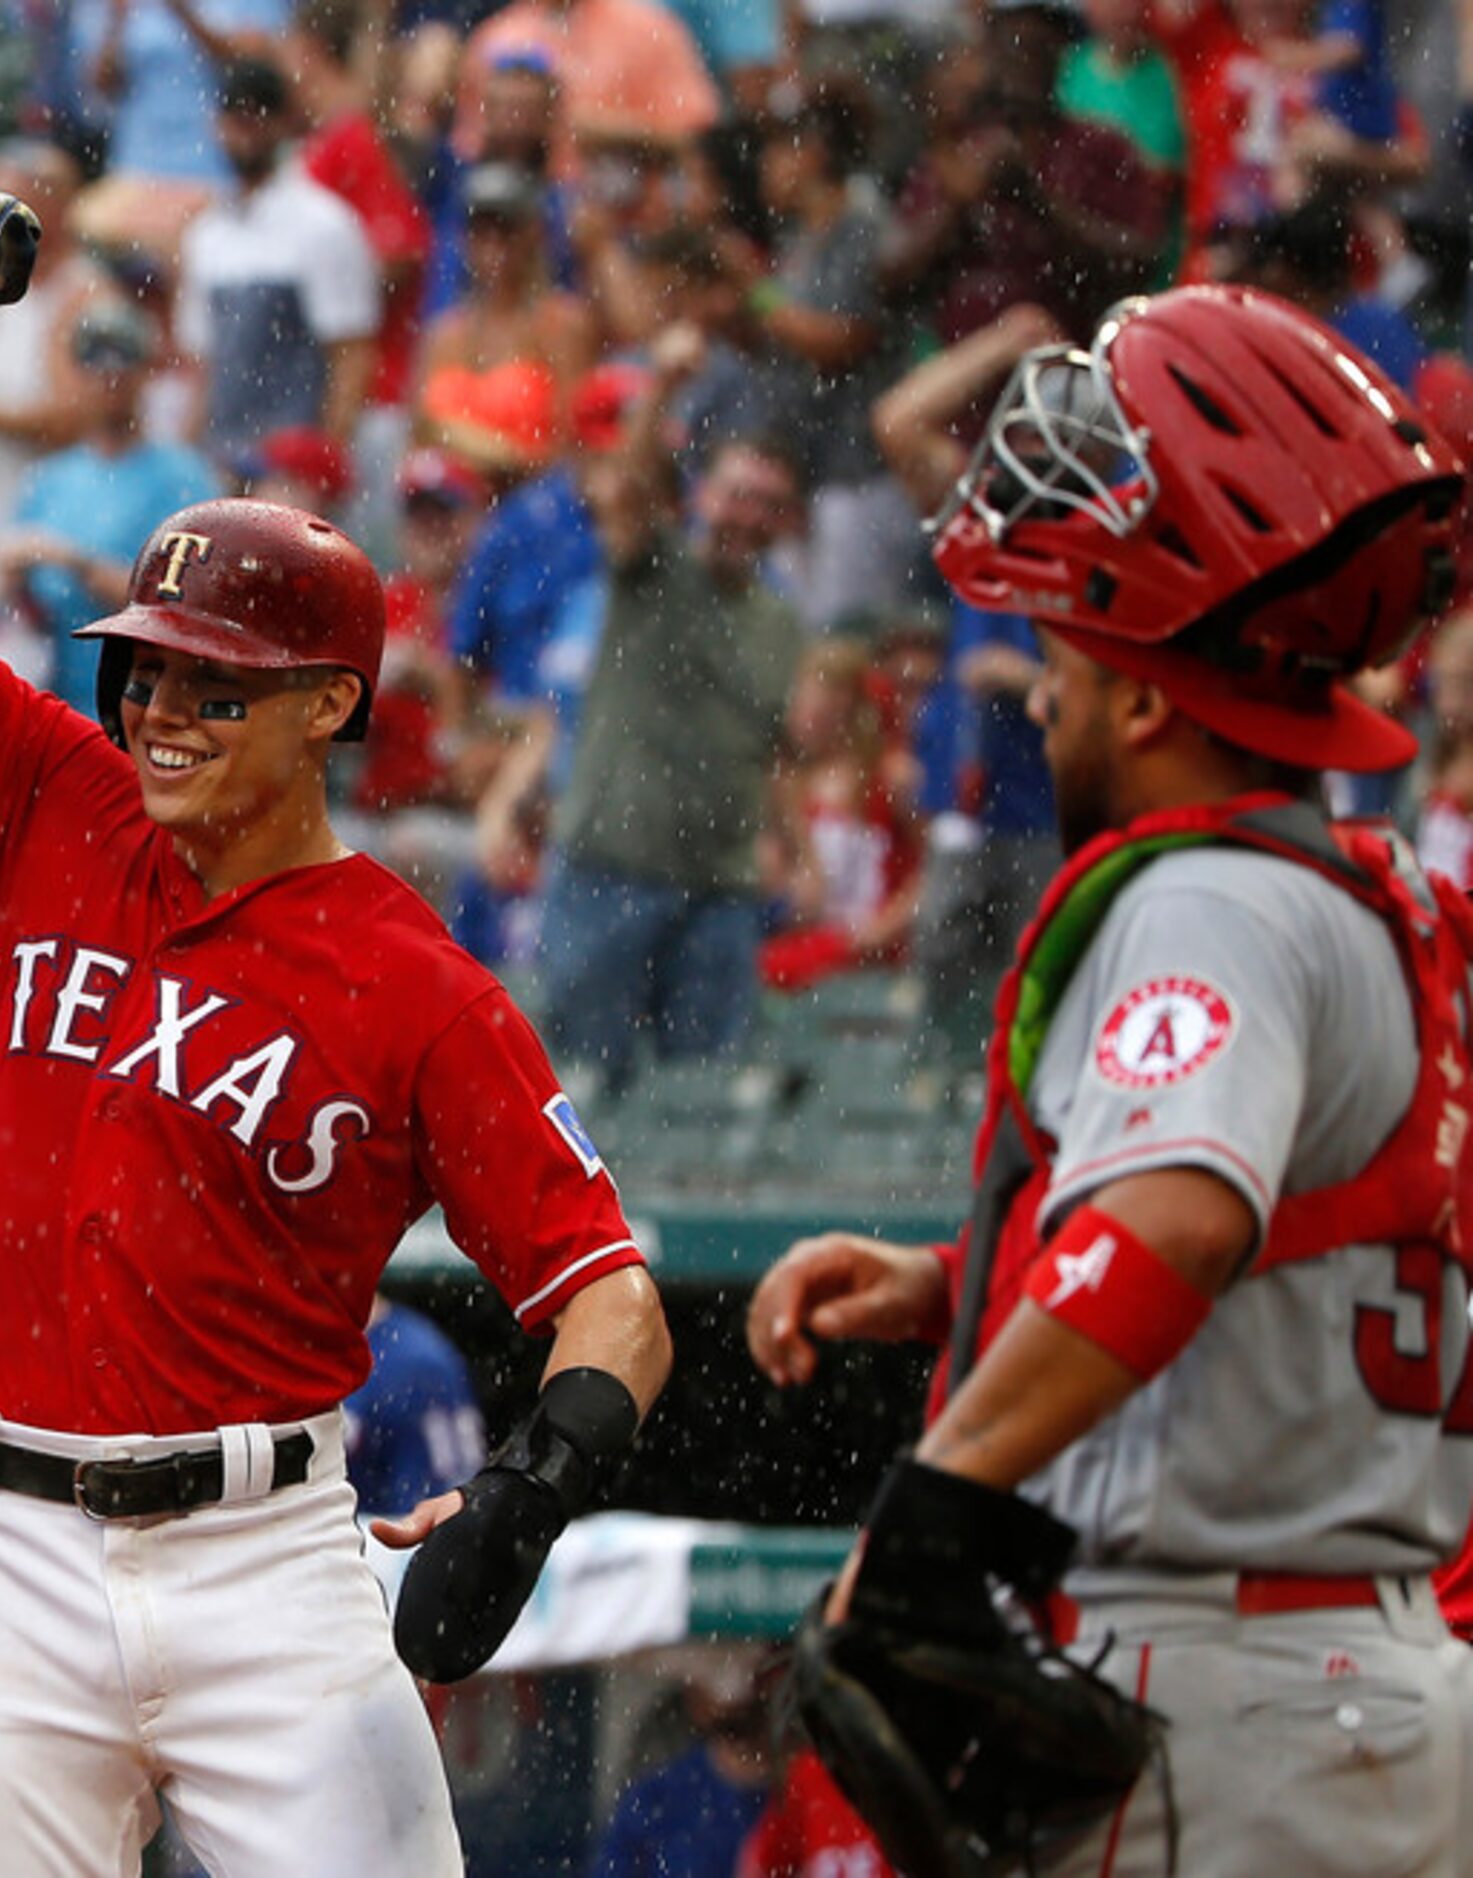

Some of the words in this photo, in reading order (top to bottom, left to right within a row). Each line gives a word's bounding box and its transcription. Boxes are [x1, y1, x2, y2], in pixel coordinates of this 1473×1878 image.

[158, 532, 213, 599] T
[7, 935, 377, 1197] TEXAS
[1138, 1006, 1176, 1063] A
